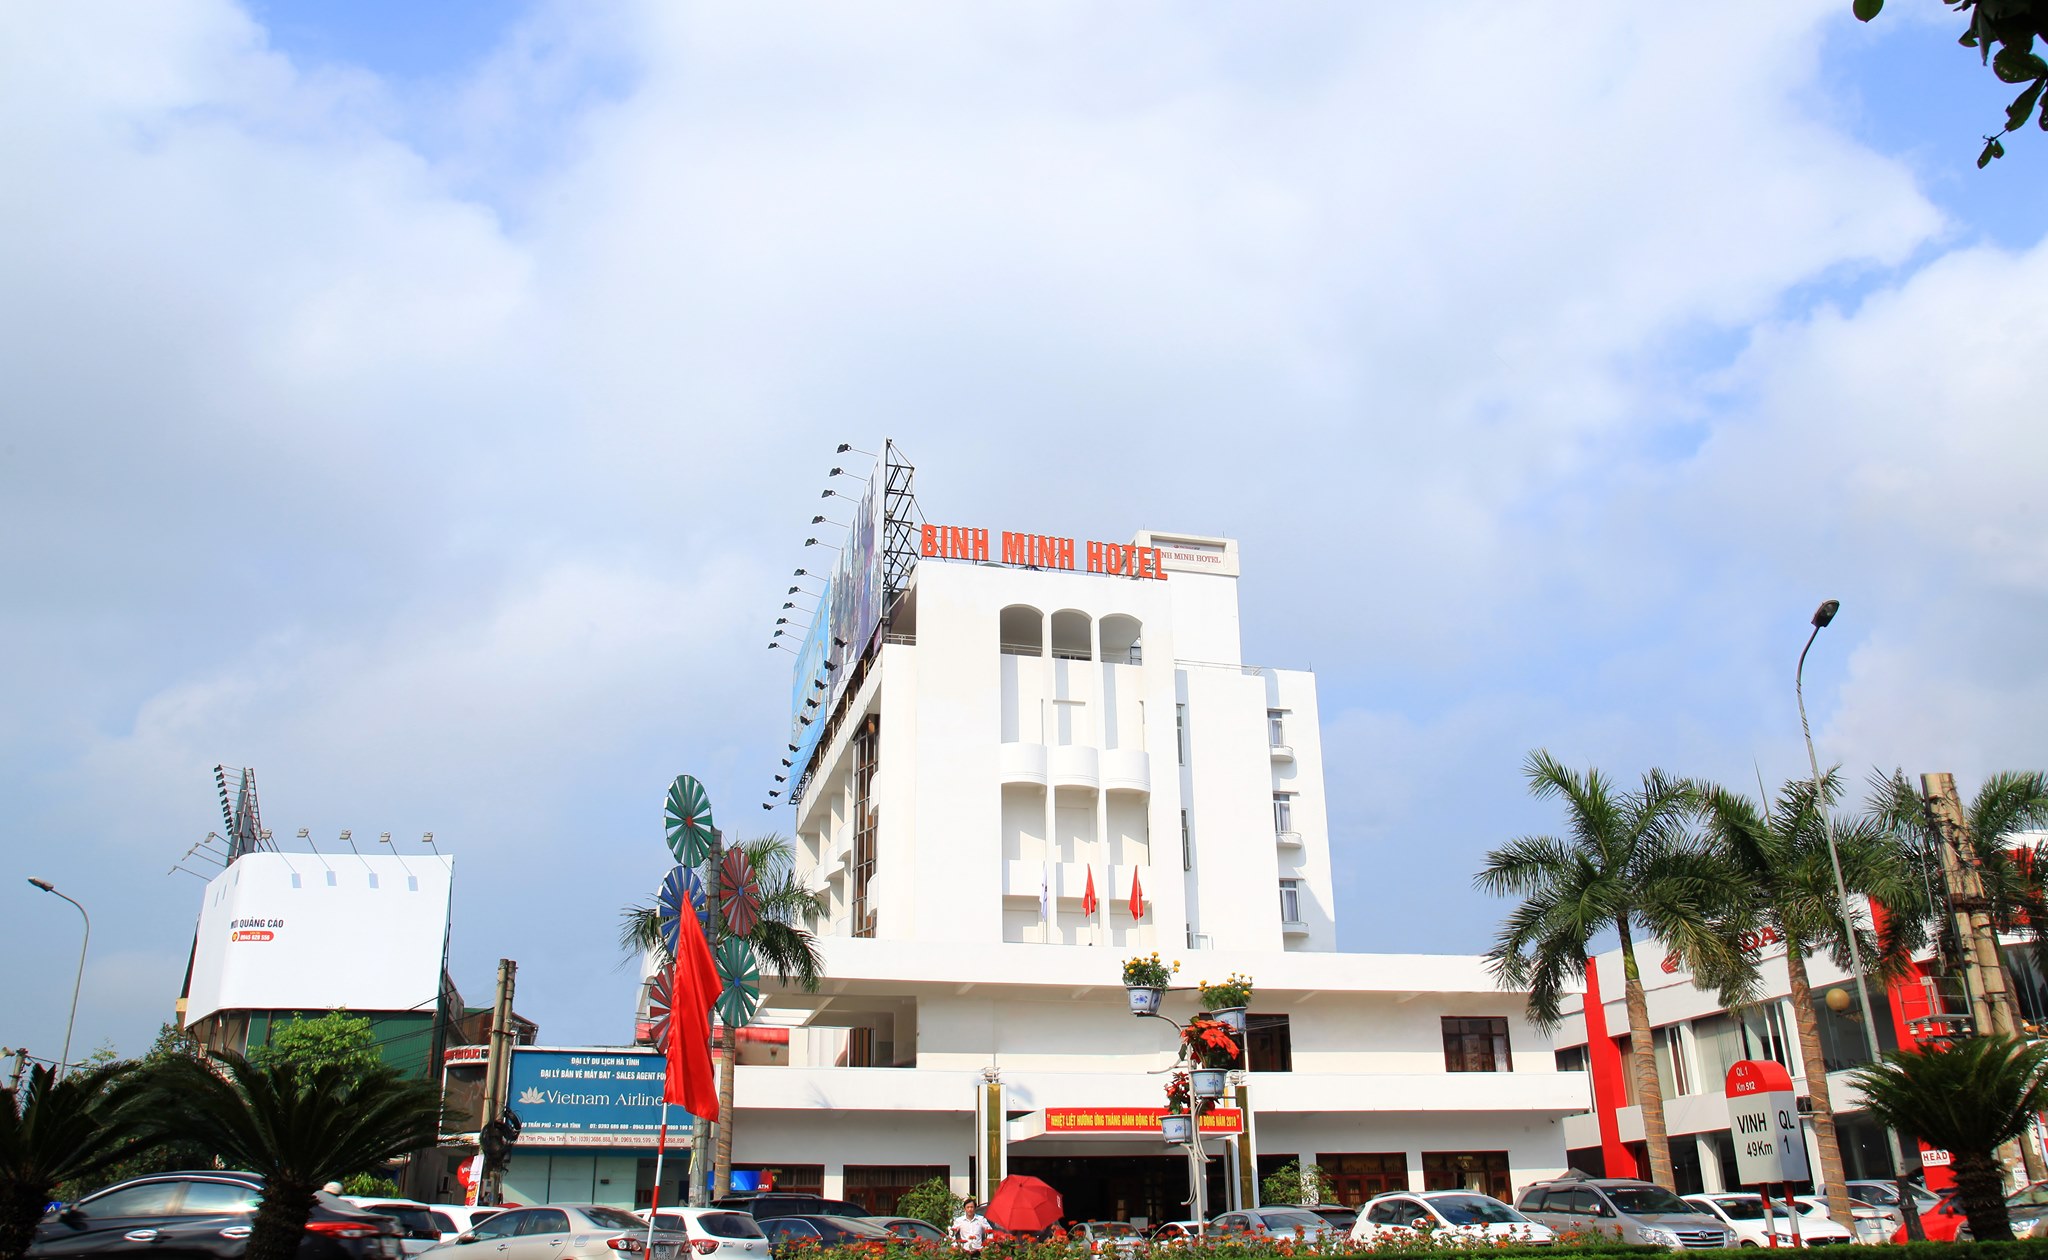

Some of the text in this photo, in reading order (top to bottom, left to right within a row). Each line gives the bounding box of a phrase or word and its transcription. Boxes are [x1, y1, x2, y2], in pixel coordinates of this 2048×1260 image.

[921, 524, 1168, 580] BINH MINH HOTEL
[1174, 552, 1195, 560] MINH
[1196, 554, 1221, 563] HOTEL
[240, 916, 266, 928] QUẢNG
[268, 918, 284, 928] CÁO
[571, 1057, 582, 1066] ĐẠI
[583, 1056, 590, 1064] LÝ
[601, 1058, 614, 1067] LỊCH
[616, 1056, 624, 1066] HÀ
[626, 1057, 640, 1066] TĨNH
[540, 1070, 551, 1079] ĐẠI
[552, 1068, 560, 1077] LÝ
[561, 1068, 573, 1078] BÁN
[575, 1068, 582, 1078] VÉ
[584, 1069, 597, 1079] MÁY
[598, 1071, 611, 1079] BAY
[616, 1071, 634, 1080] SALES
[636, 1072, 655, 1080] AGENT
[1736, 1066, 1748, 1076] QL 1
[1736, 1081, 1756, 1092] Km 512
[546, 1090, 610, 1105] Vietnam
[1066, 1113, 1076, 1129] LIỆT
[1076, 1110, 1093, 1126] HƯỞNG
[1094, 1112, 1105, 1126] ỨNG
[1105, 1112, 1121, 1126] THÁNG
[1122, 1113, 1135, 1126] HÀNH
[1136, 1113, 1148, 1129] ĐỘNG
[1216, 1113, 1225, 1127] NĂM
[1736, 1112, 1767, 1134] VINH
[1778, 1110, 1795, 1130] QL
[1746, 1140, 1773, 1157] 49Km
[1784, 1135, 1790, 1154] 1
[1923, 1151, 1948, 1162] HEAD
